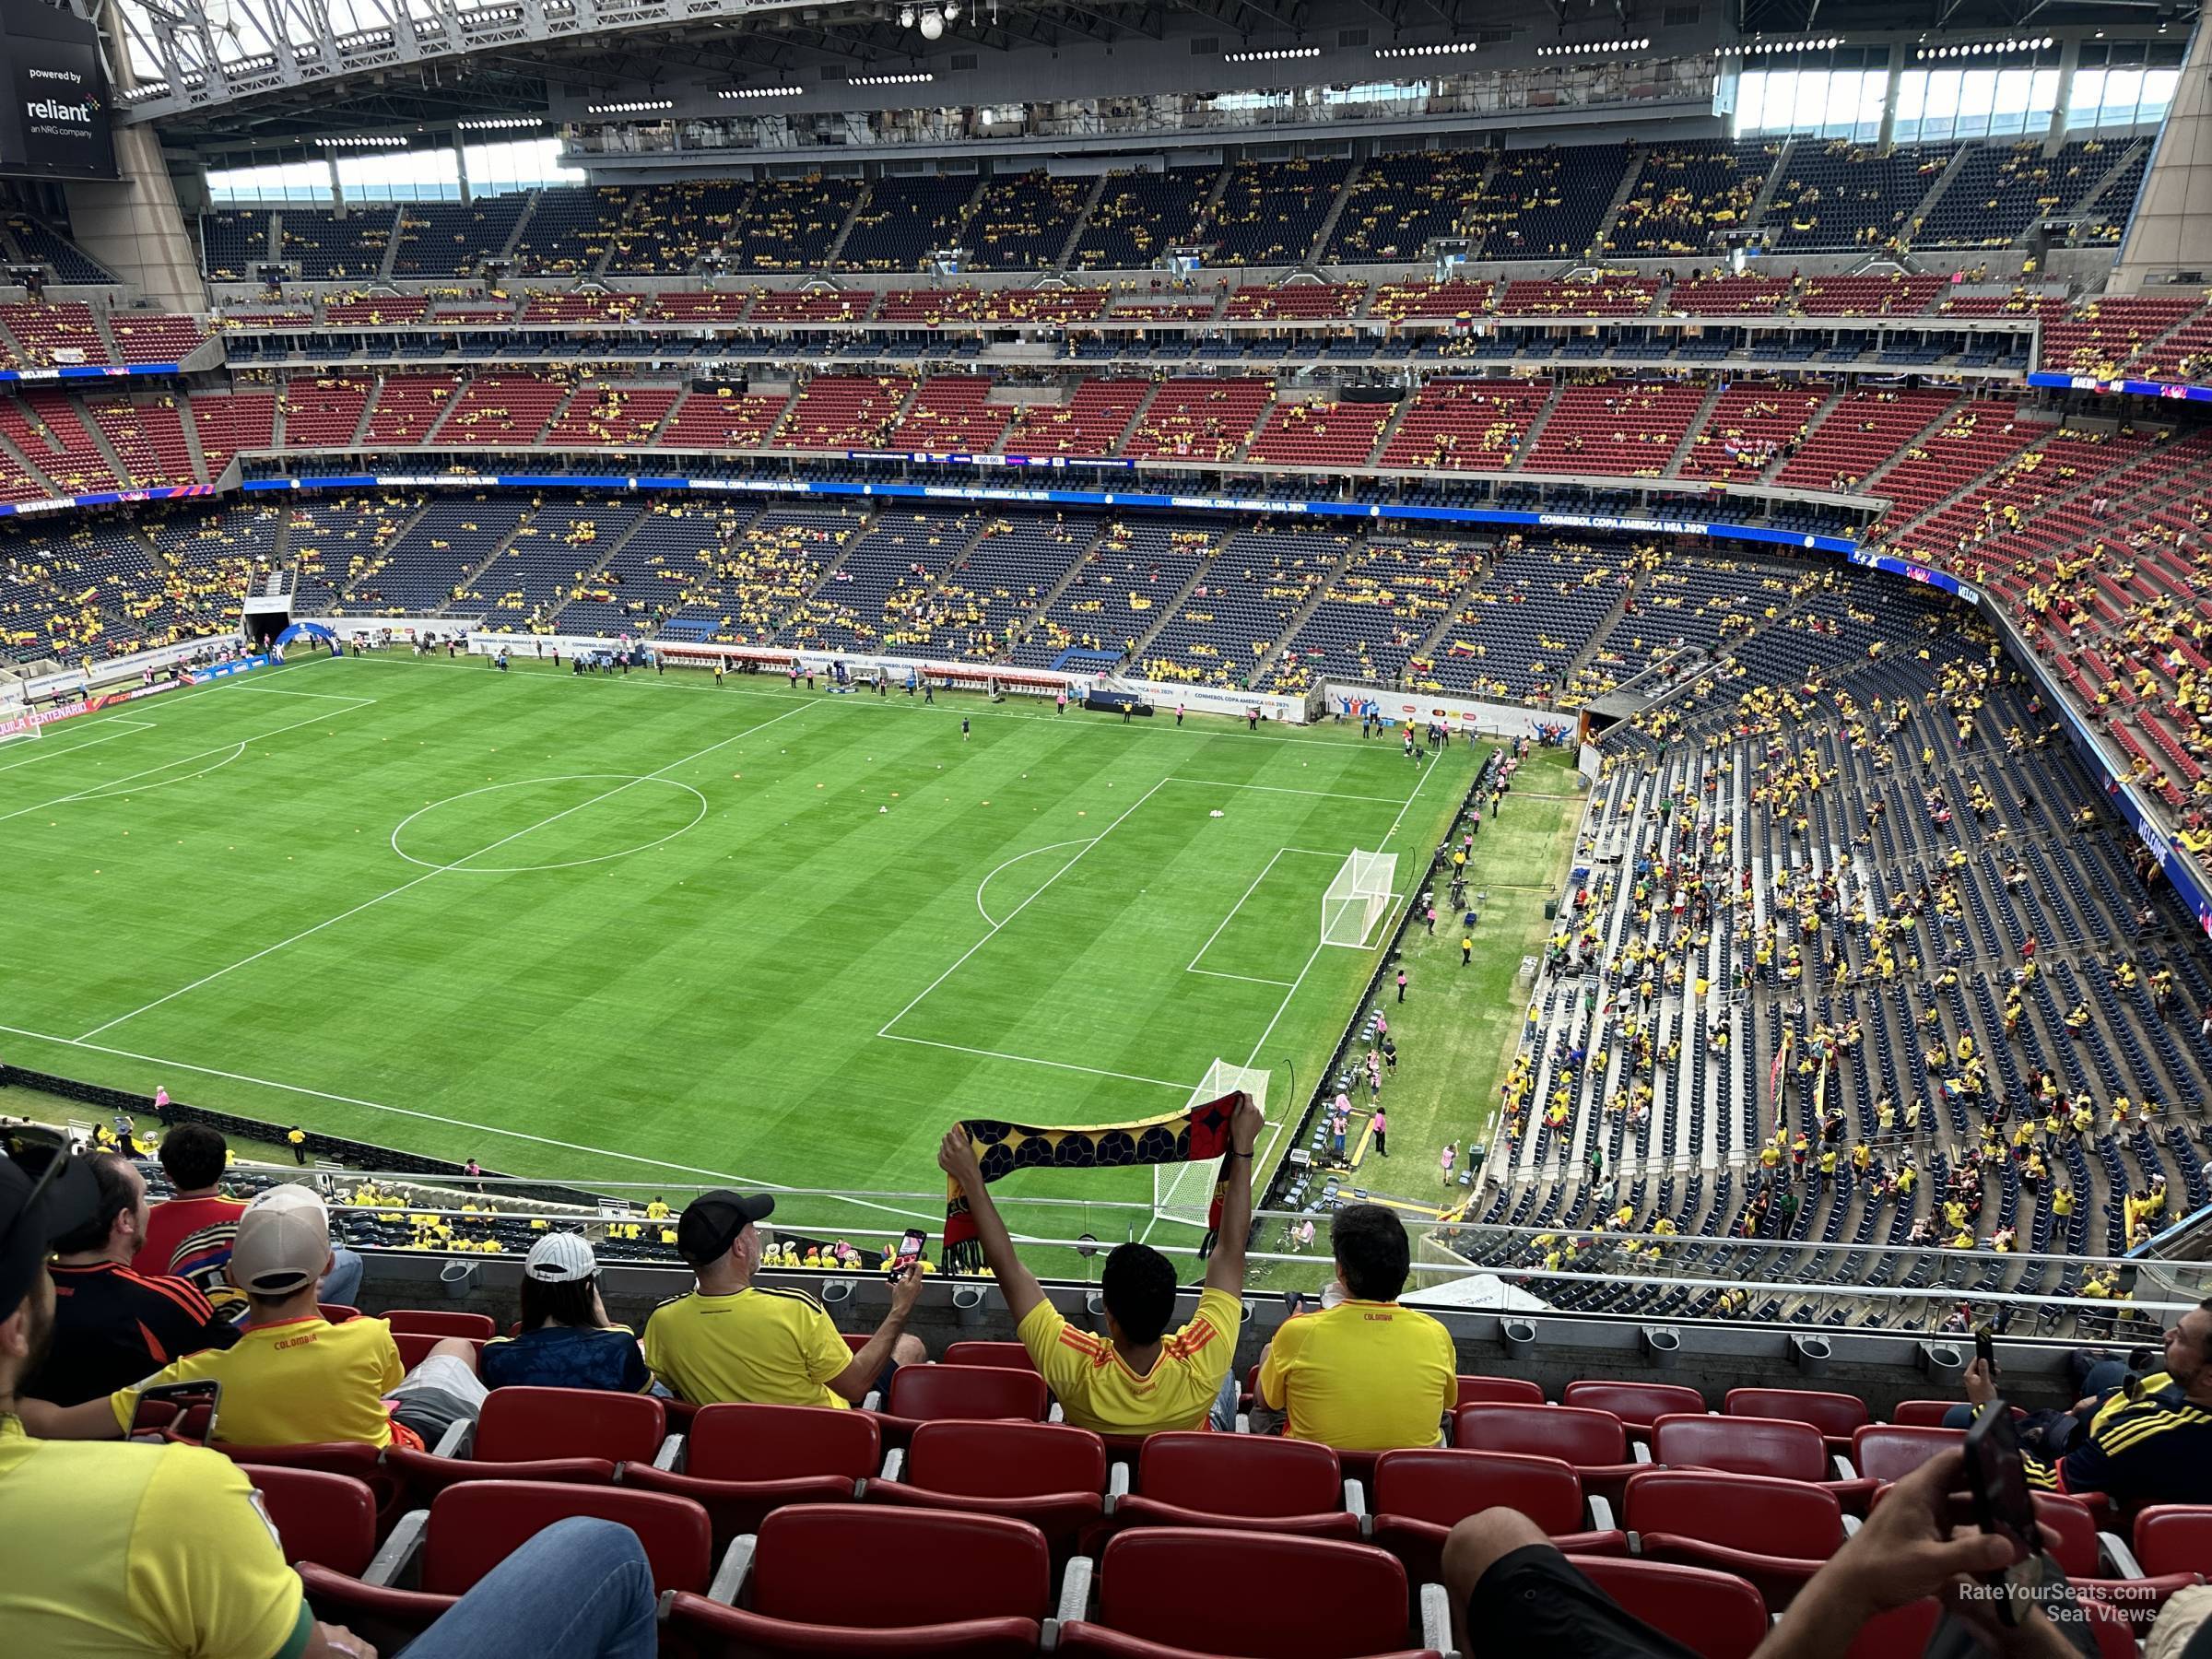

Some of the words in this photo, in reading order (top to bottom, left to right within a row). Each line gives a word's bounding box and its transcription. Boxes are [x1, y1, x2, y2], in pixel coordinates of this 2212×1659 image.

[29, 69, 70, 80] powered
[70, 72, 81, 84] by
[27, 99, 90, 122] reliant
[41, 125, 58, 135] NRG
[59, 128, 92, 139] company
[1214, 499, 1236, 509] COPA
[1539, 514, 1592, 527] CONMEBOL
[1592, 517, 1618, 529] COPA
[1618, 519, 1663, 531] AMERICA
[1664, 522, 1684, 533] USA
[1684, 524, 1710, 535] 2024
[1194, 691, 1224, 701] CONMEBOL
[1276, 700, 1289, 709] 2024
[29, 701, 88, 725] CENTENARIO
[2137, 817, 2168, 868] WELCOME
[274, 1334, 318, 1351] COLOMBIA
